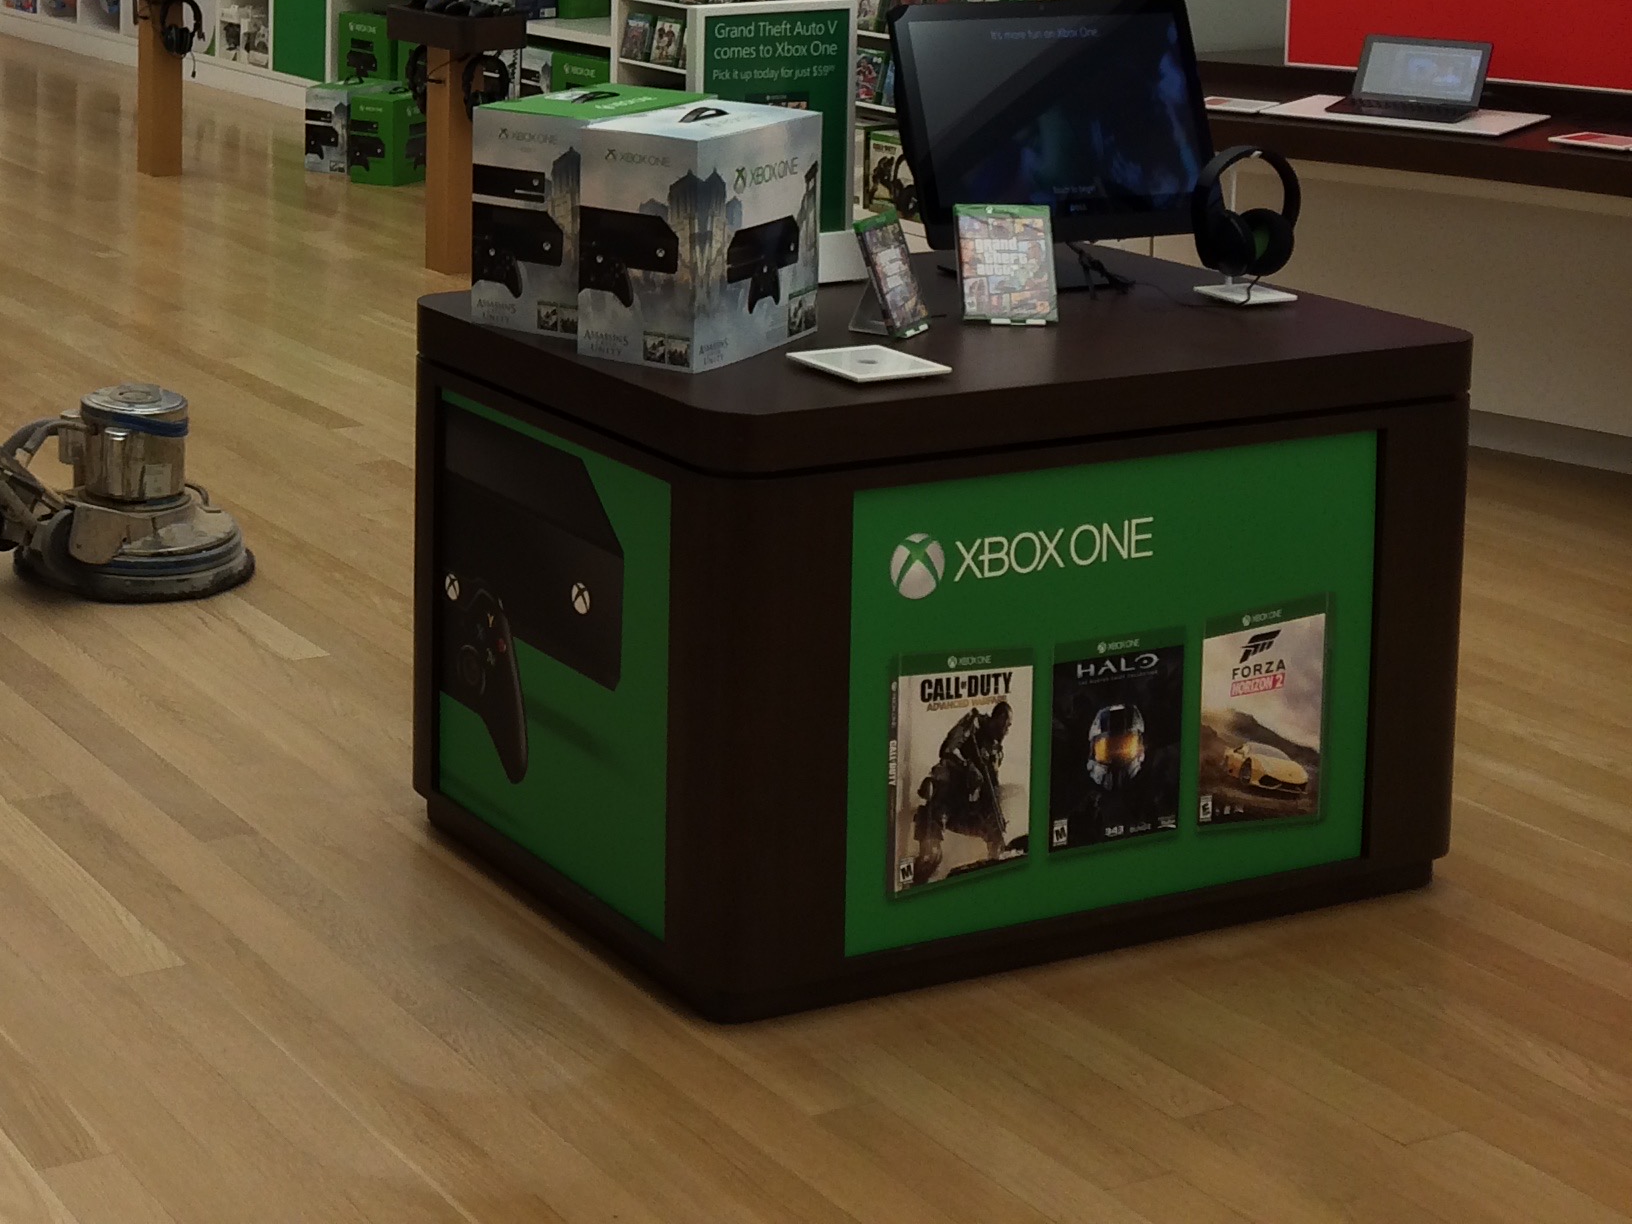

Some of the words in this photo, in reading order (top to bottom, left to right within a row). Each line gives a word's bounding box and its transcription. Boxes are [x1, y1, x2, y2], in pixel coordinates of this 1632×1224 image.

[714, 22, 755, 38] Grand
[758, 20, 791, 36] Theft
[793, 21, 825, 36] Auto
[827, 20, 838, 35] V
[714, 46, 756, 59] comes
[759, 44, 773, 58] to
[775, 41, 807, 57] Xbox
[810, 40, 838, 55] One
[712, 69, 730, 80] Pick
[732, 69, 739, 79] it
[740, 71, 752, 82] up
[753, 67, 779, 81] today
[780, 66, 793, 78] for
[794, 67, 810, 80] just
[511, 131, 536, 142] XBOX
[620, 153, 648, 165] XBOX
[648, 156, 671, 167] ONE
[748, 162, 777, 188] XBOX
[777, 157, 798, 179] ONE
[954, 528, 1065, 582] XBOX
[1070, 516, 1154, 566] ONE
[1107, 640, 1125, 651] XBOX
[1125, 638, 1140, 649] ONE
[958, 656, 976, 665] XBOX
[976, 655, 992, 664] ONE
[1077, 653, 1159, 678] HALO
[1232, 659, 1286, 680] FORZA
[920, 676, 964, 703] CALL
[967, 671, 1013, 697] DUTY
[1232, 677, 1273, 697] HORIZON
[1274, 673, 1284, 687] 2
[900, 863, 913, 882] M
